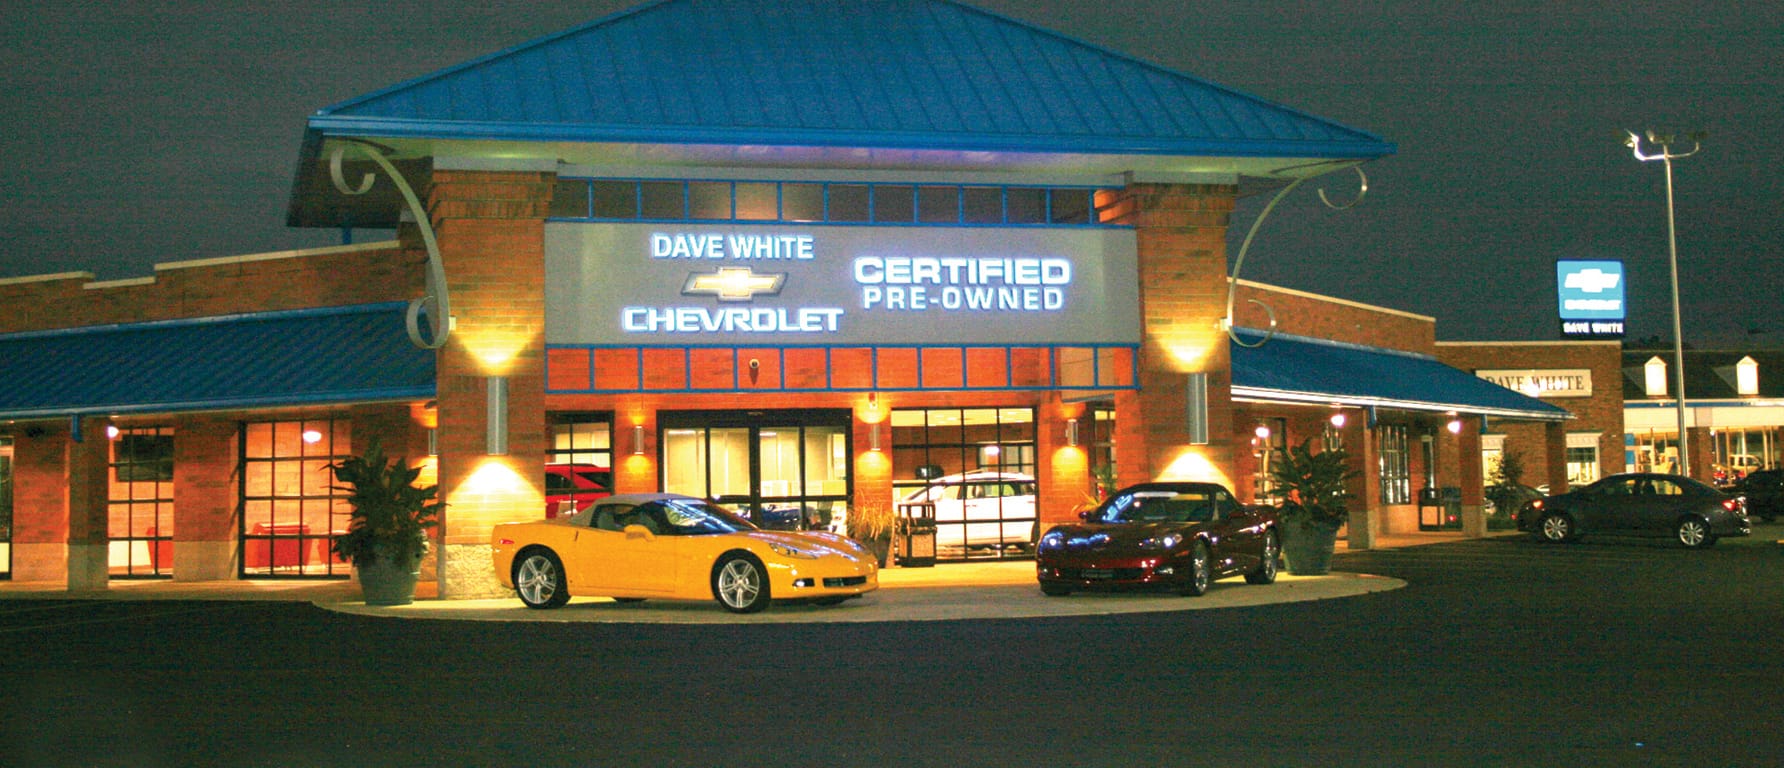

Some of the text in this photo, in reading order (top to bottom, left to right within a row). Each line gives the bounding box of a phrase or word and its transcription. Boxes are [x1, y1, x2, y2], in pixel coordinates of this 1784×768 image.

[652, 234, 814, 260] DAVE WHITE
[853, 256, 1071, 285] CERTIFIED
[863, 286, 1064, 311] PRE-OWNED
[623, 307, 843, 332] CHEVROLET
[1532, 375, 1585, 391] WHITE
